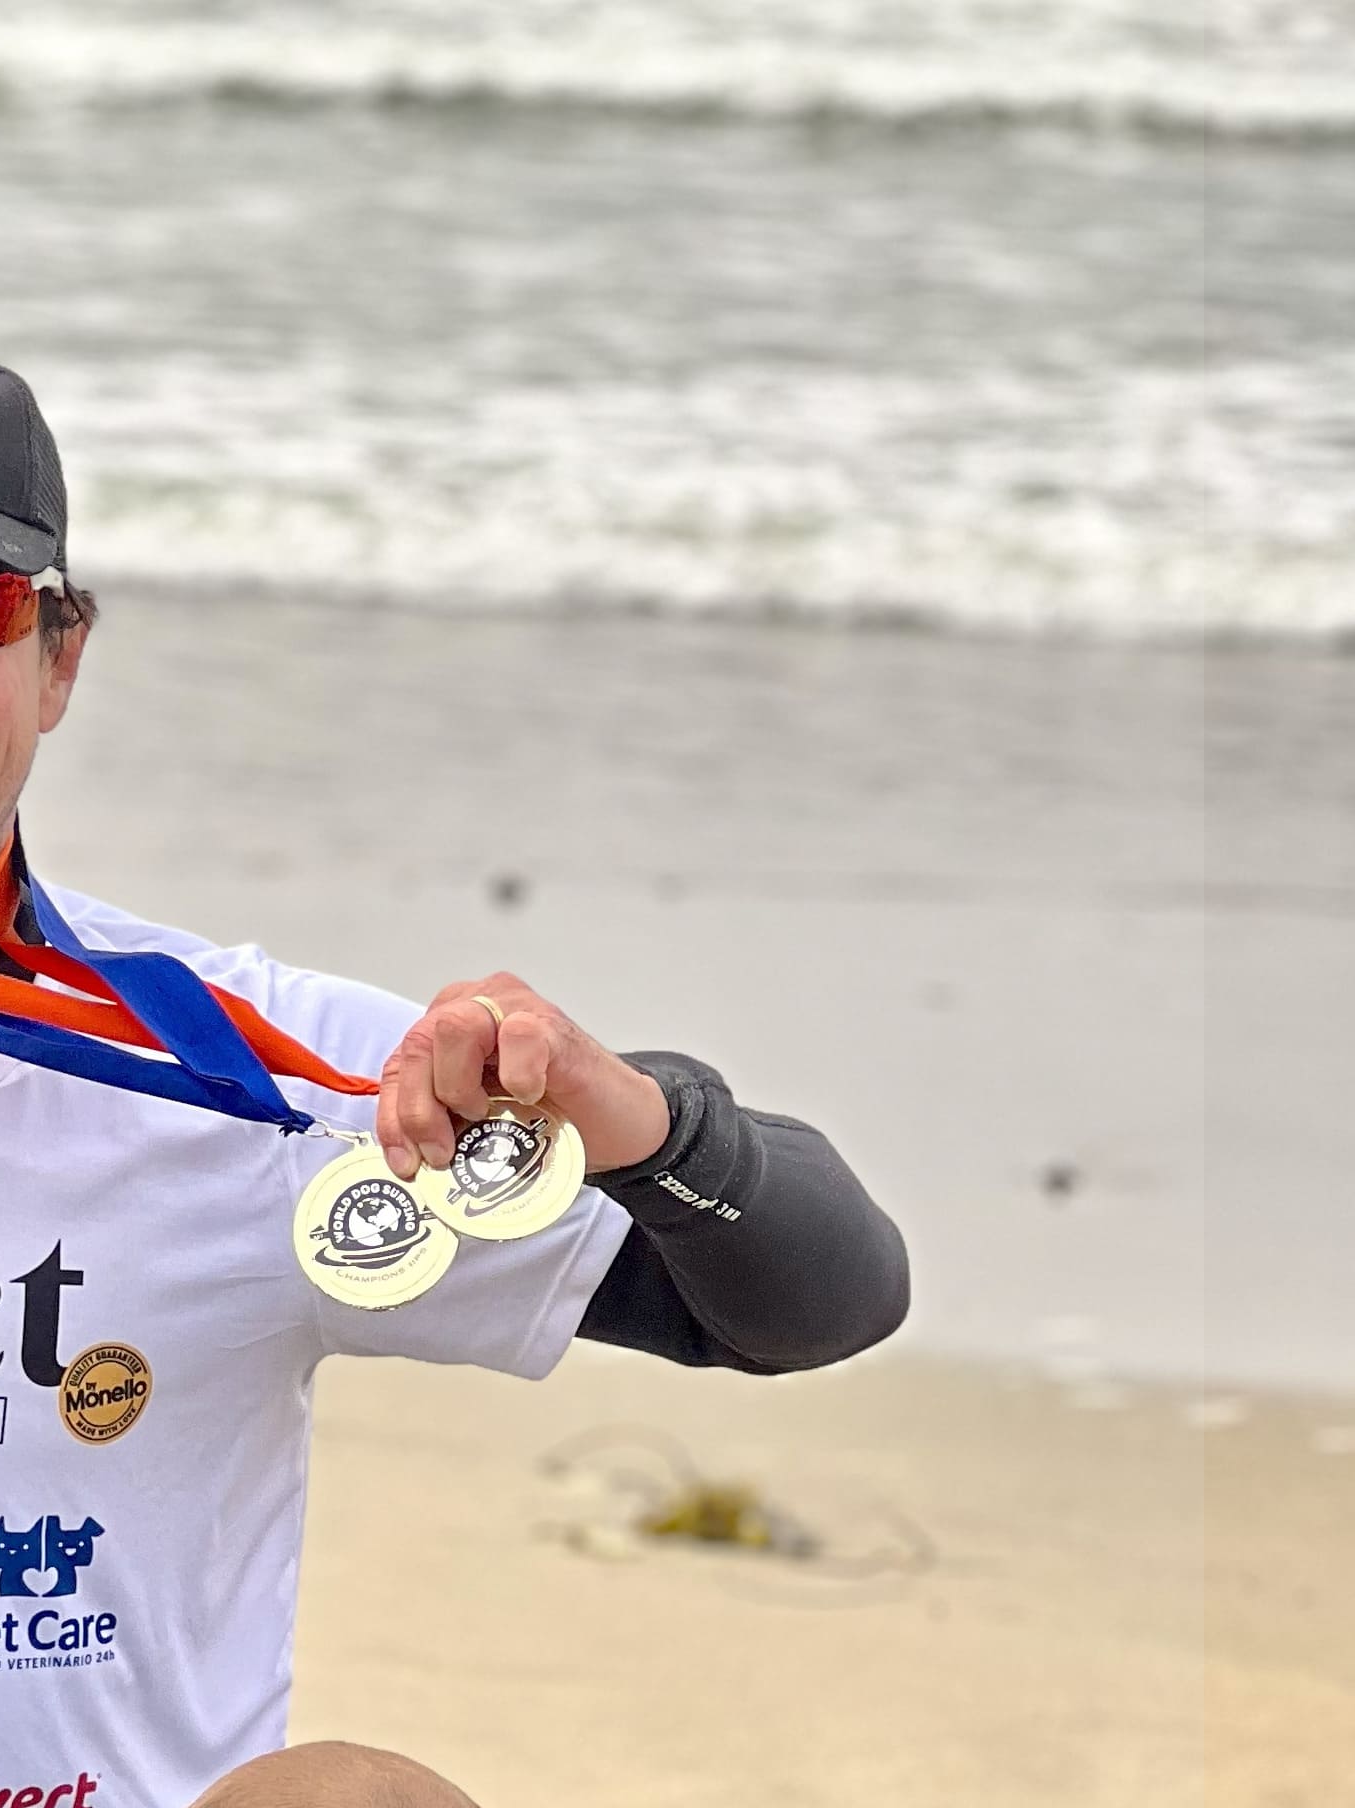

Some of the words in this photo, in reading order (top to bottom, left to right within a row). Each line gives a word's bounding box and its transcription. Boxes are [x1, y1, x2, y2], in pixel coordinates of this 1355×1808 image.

[457, 1127, 482, 1152] DOG
[482, 1122, 536, 1150] SURFING
[454, 1152, 480, 1193] WORLD
[332, 1197, 352, 1244] WORLD
[350, 1182, 381, 1200] DOG
[381, 1184, 417, 1232] SURFING
[68, 1355, 94, 1387] QUALITY
[65, 1378, 148, 1413] Monello
[75, 1420, 97, 1437] MADE
[98, 1426, 118, 1436] WITH
[119, 1407, 137, 1428] LOVE
[27, 1609, 118, 1652] Care
[7, 1653, 93, 1671] VETERINÁRIO
[95, 1648, 116, 1664] 24h
